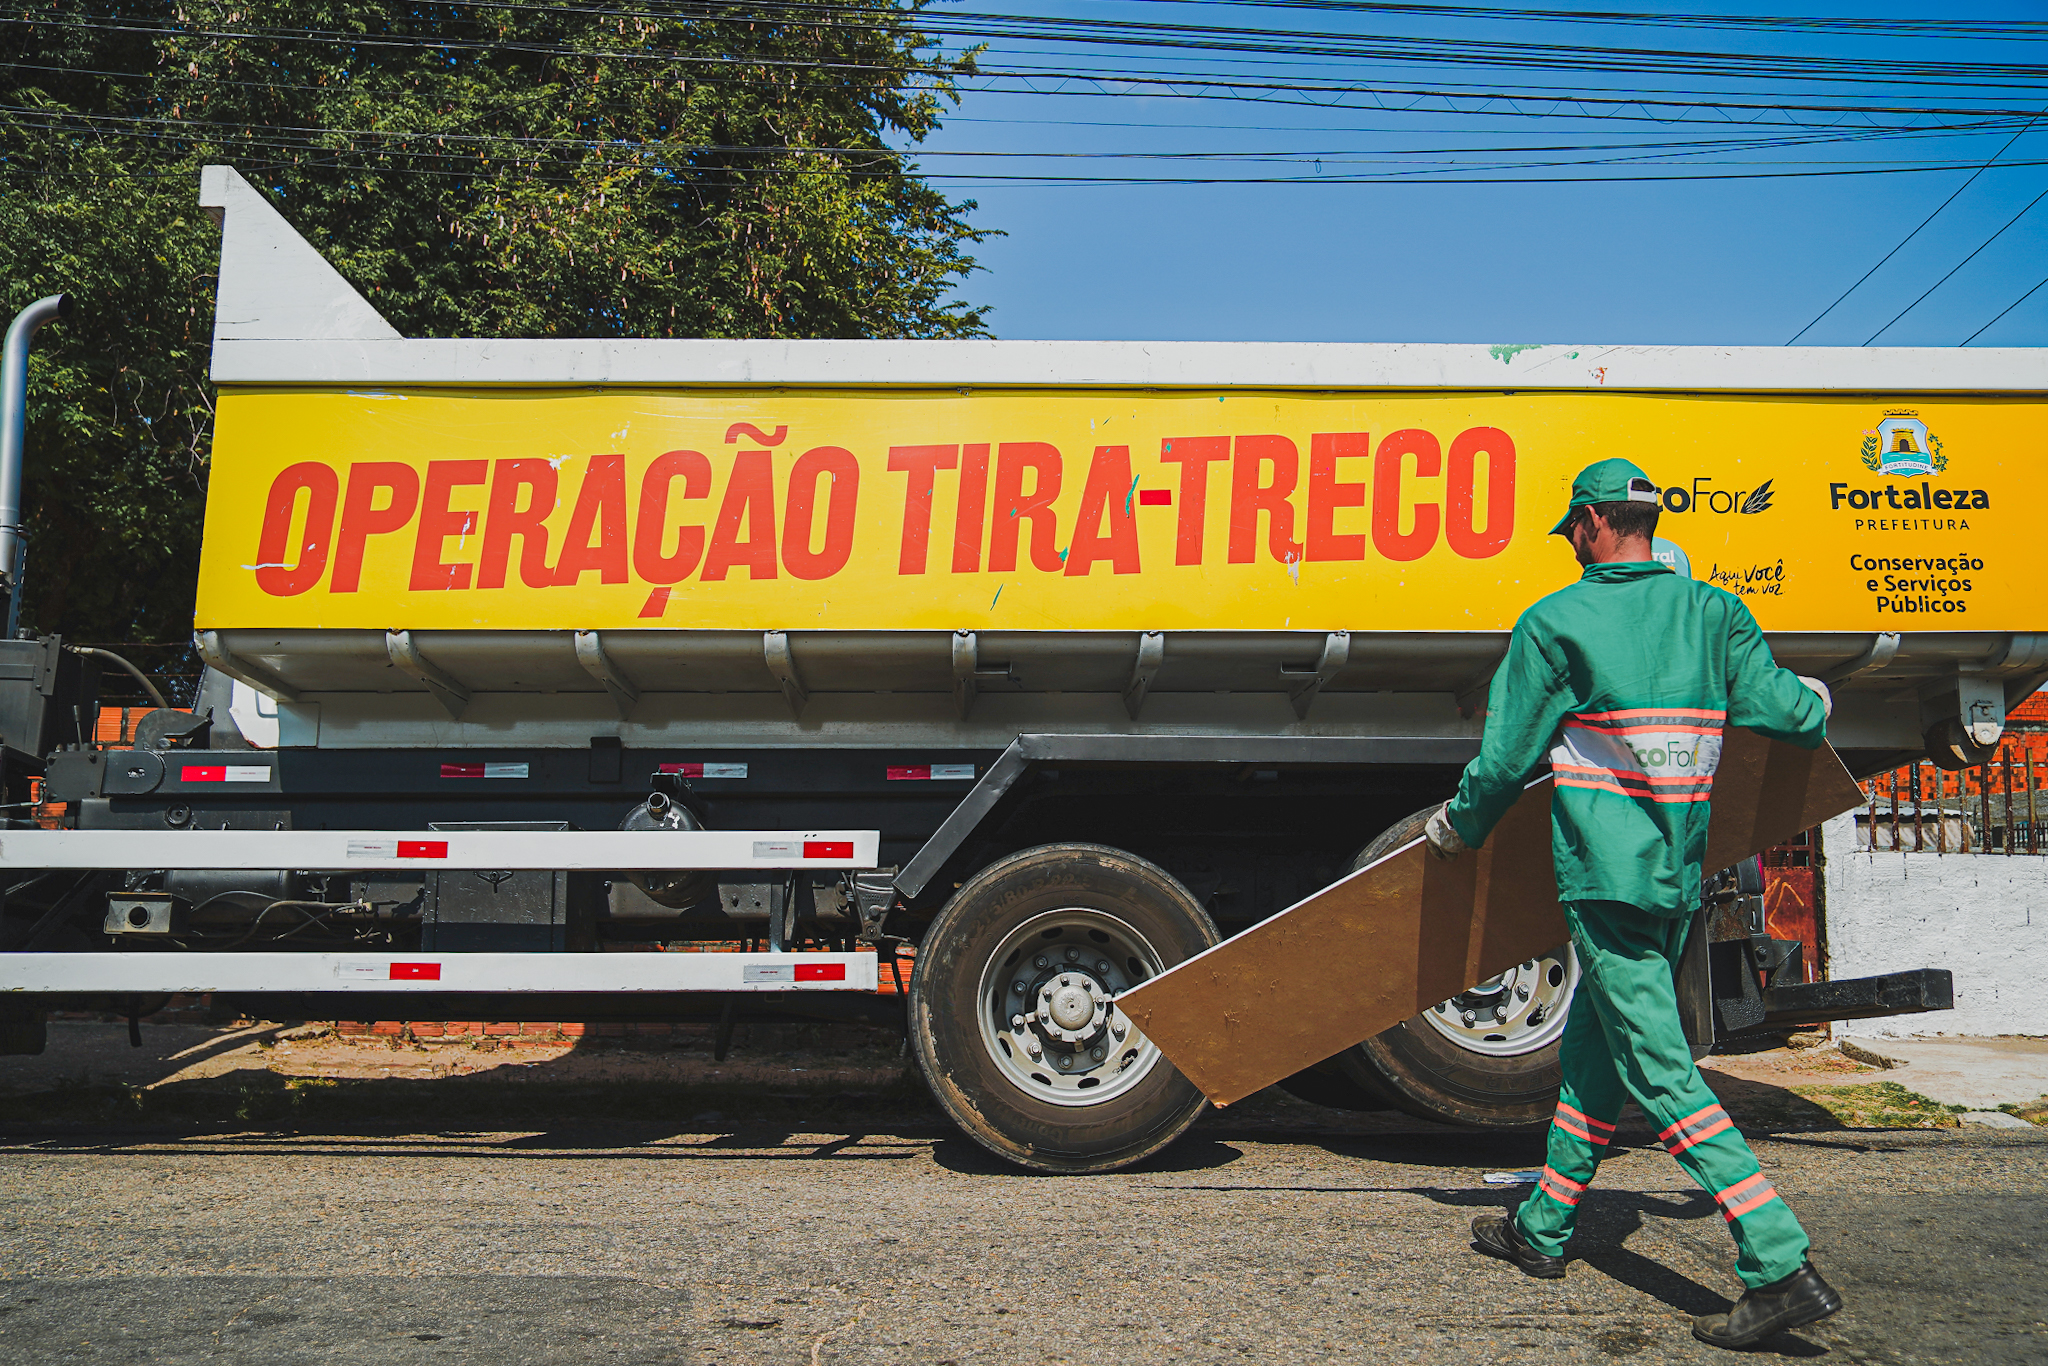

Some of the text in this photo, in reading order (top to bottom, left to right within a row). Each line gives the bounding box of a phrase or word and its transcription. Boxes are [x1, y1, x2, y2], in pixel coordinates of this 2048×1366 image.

[1884, 461, 1930, 472] FORTITUDINE
[1655, 477, 1747, 514] oFor
[1829, 481, 1991, 510] Fortaleza
[256, 422, 1517, 619] OPERAÇÃO TIRA-TRECO
[1855, 519, 1970, 531] PREFEITURA
[1850, 552, 1984, 576] Conservação
[1866, 574, 1973, 597] e Serviços
[1876, 594, 1967, 614] Públicos
[1625, 741, 1696, 768] coFor
